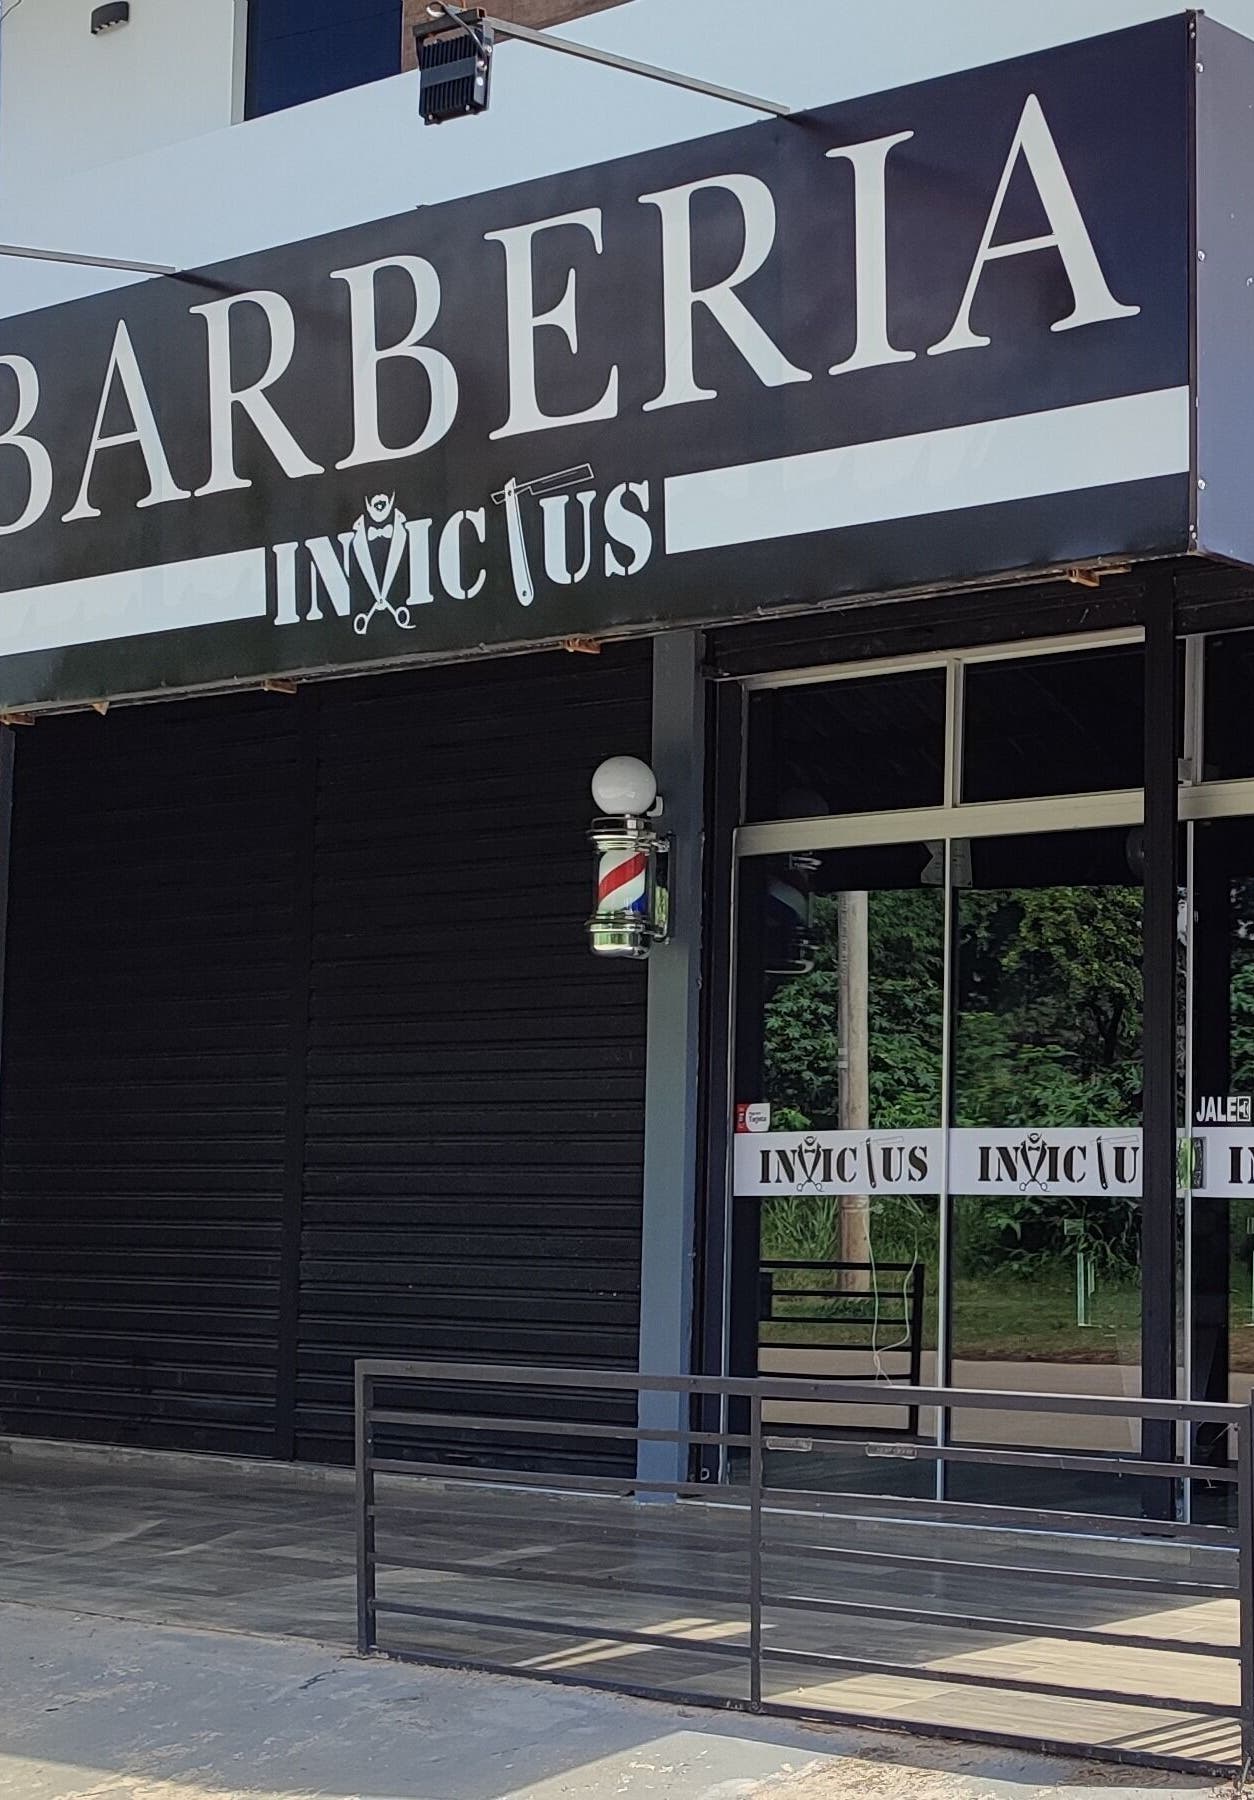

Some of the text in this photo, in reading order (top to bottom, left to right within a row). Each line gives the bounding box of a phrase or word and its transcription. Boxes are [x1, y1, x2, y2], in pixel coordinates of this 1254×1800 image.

[272, 463, 653, 634] INVICTUS
[759, 1135, 929, 1192] INVICTUS
[978, 1133, 1140, 1192] INVICTU
